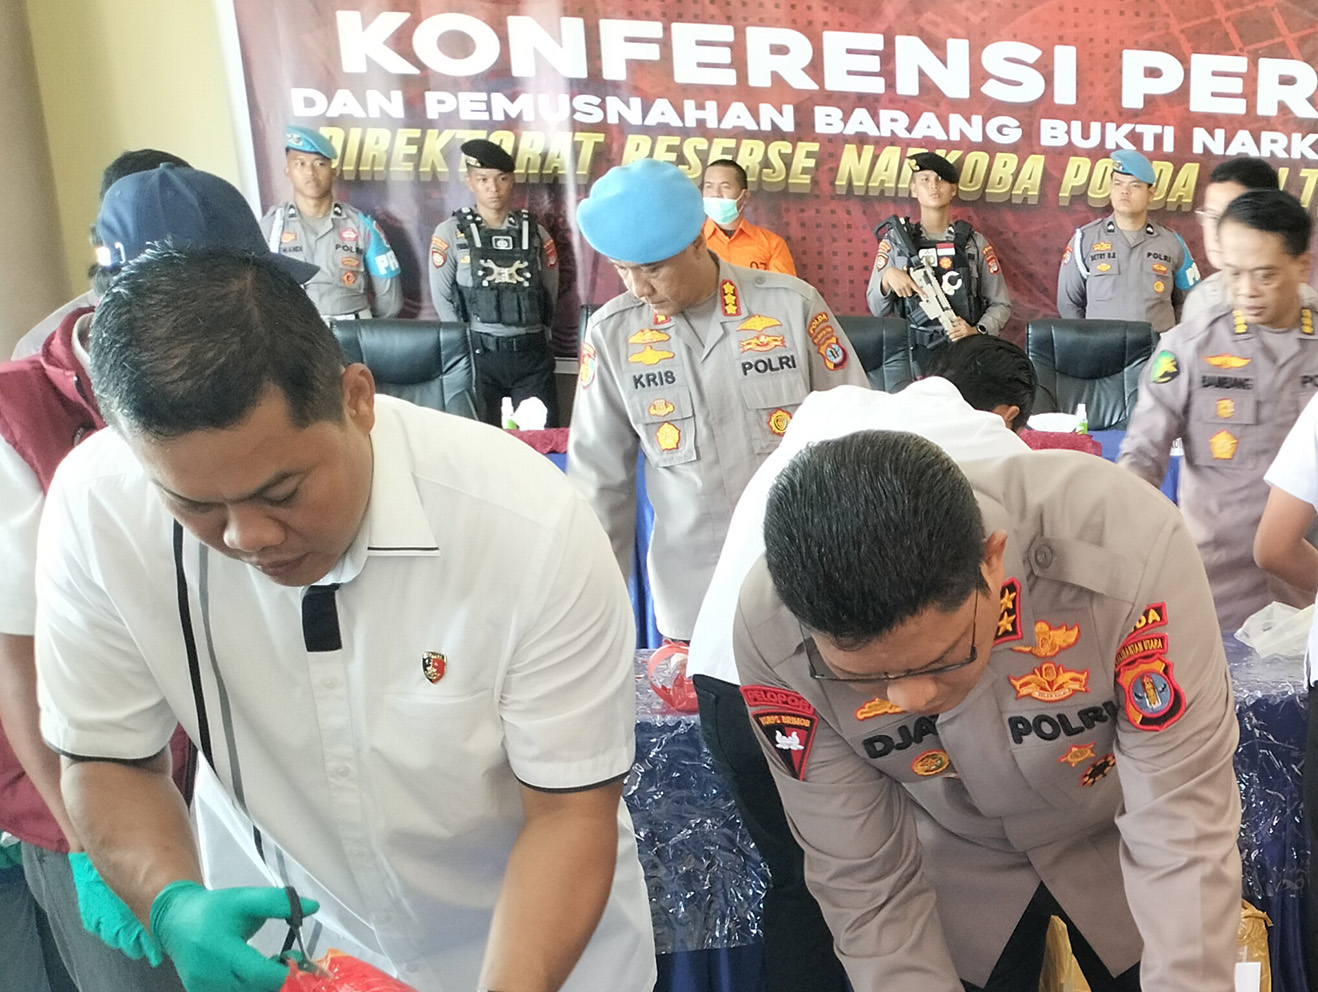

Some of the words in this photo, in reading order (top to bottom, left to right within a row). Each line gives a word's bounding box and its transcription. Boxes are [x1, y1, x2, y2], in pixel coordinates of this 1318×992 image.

[336, 9, 1076, 105] KONFERENSI
[291, 88, 402, 119] DAN
[424, 90, 794, 133] PEMUSNAHAN
[814, 105, 1022, 145] BARANG
[1040, 118, 1175, 153] BUKTI
[632, 369, 677, 390] KRIS
[741, 354, 797, 377] POLRI
[1008, 701, 1120, 744] POLRI
